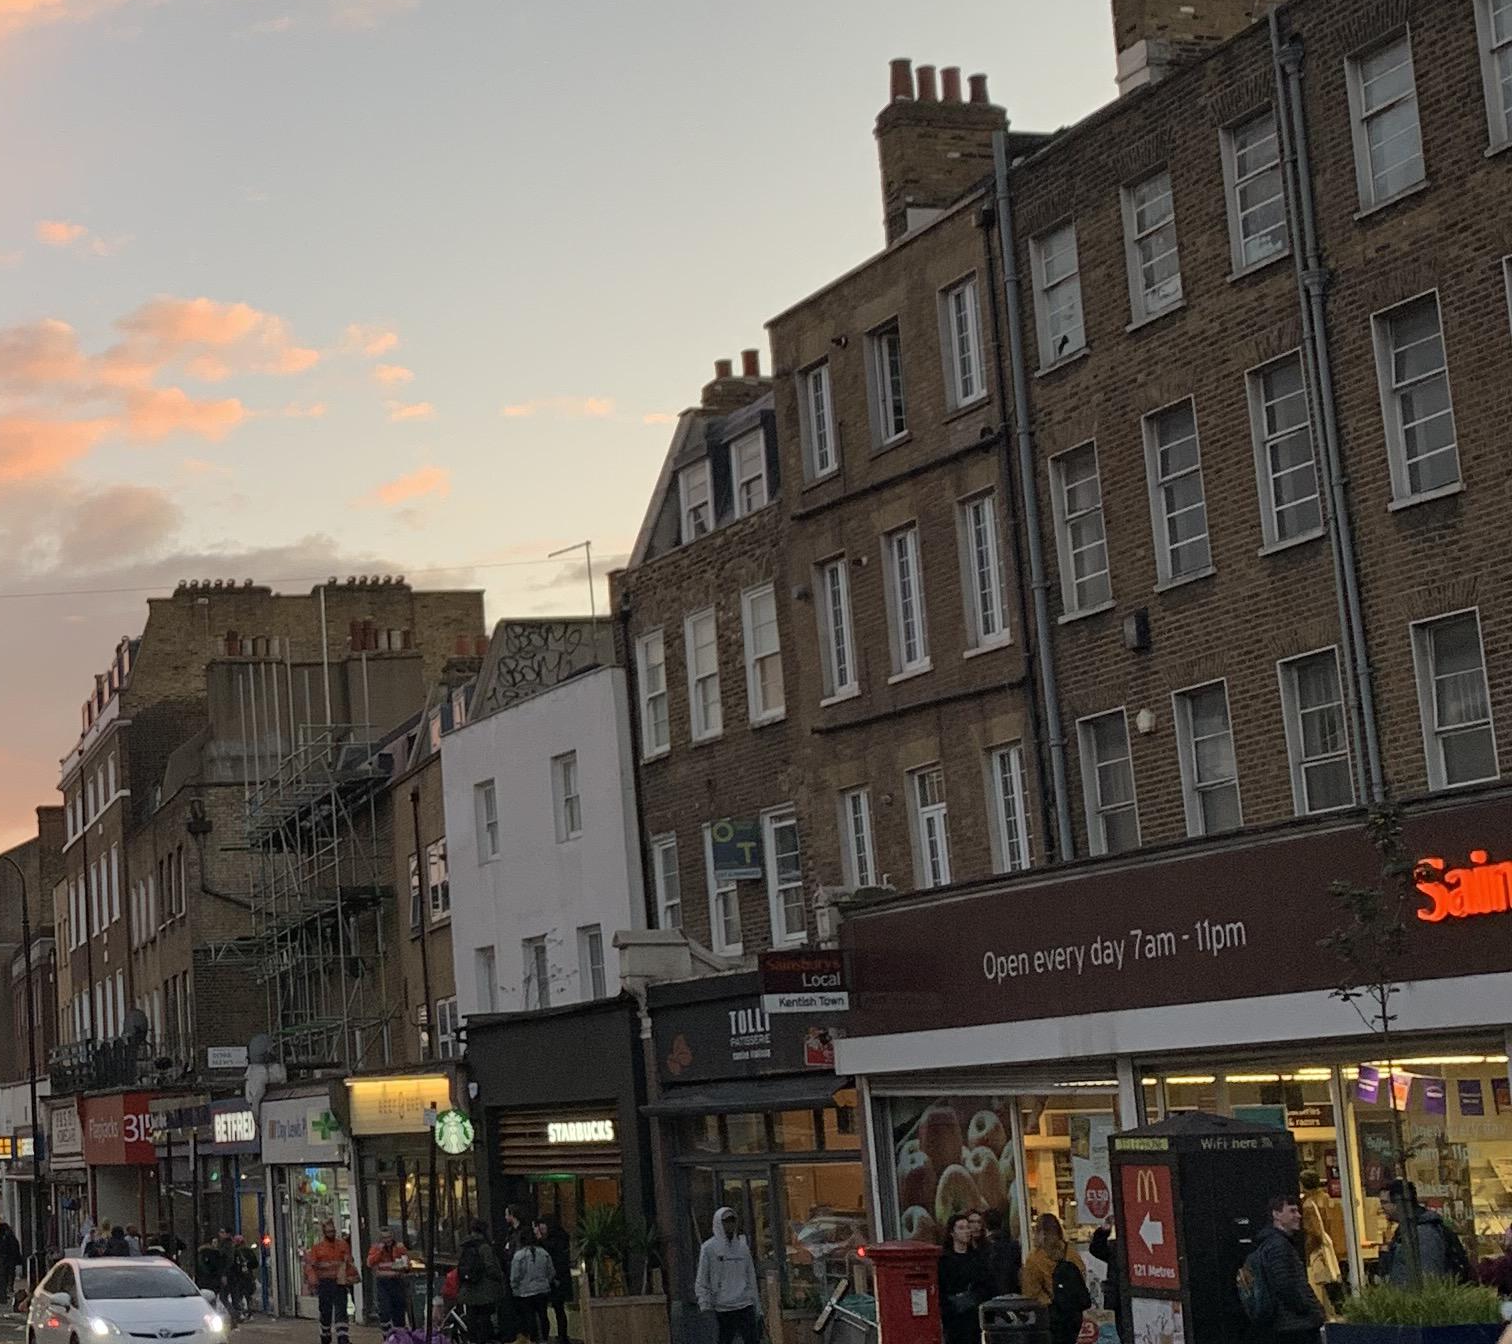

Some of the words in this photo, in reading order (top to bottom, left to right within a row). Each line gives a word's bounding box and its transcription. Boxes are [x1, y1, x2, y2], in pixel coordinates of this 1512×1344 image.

[983, 951, 1029, 985] Open
[1034, 944, 1085, 975] every
[1091, 935, 1125, 971] day
[1130, 929, 1177, 960] 7am
[1194, 918, 1247, 957] 11pm
[801, 971, 841, 988] Local
[778, 996, 817, 1008] Kentish
[818, 996, 845, 1006] Town
[213, 1110, 256, 1144] BETFRED
[547, 1119, 614, 1143] STARBUCKS
[1200, 1137, 1227, 1150] WiFi
[1231, 1137, 1258, 1149] here
[1133, 1263, 1146, 1277] 121
[1148, 1264, 1176, 1278] Metres
